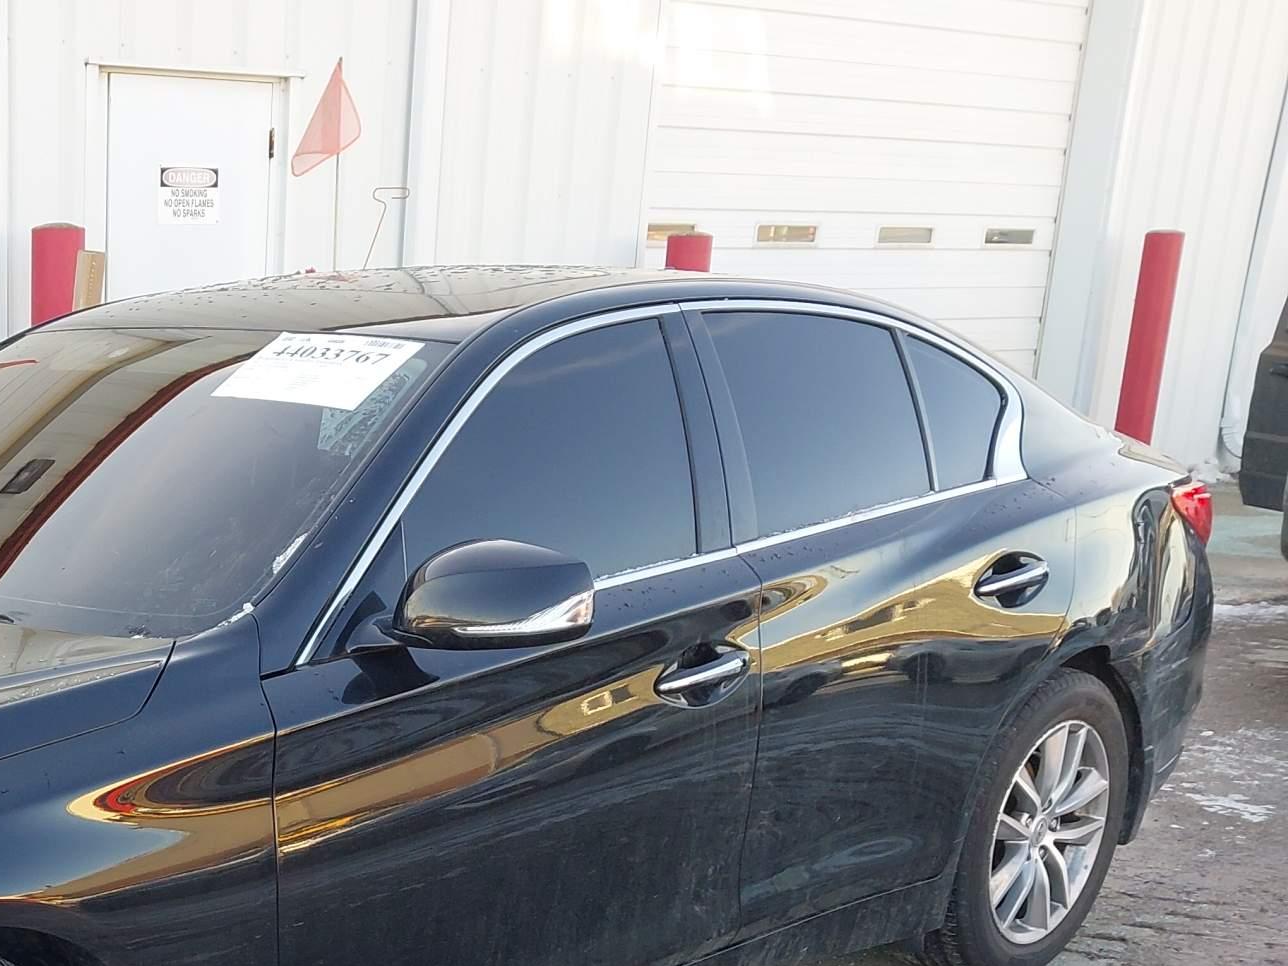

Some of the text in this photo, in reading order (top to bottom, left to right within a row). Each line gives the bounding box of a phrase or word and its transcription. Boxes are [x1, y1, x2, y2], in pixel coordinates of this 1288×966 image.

[168, 171, 210, 183] DANGER
[171, 188, 208, 198] NO SMOKING
[164, 198, 214, 207] NO OPEN FLAMES
[172, 208, 206, 218] NO SPARKS
[272, 344, 391, 366] 44033767
